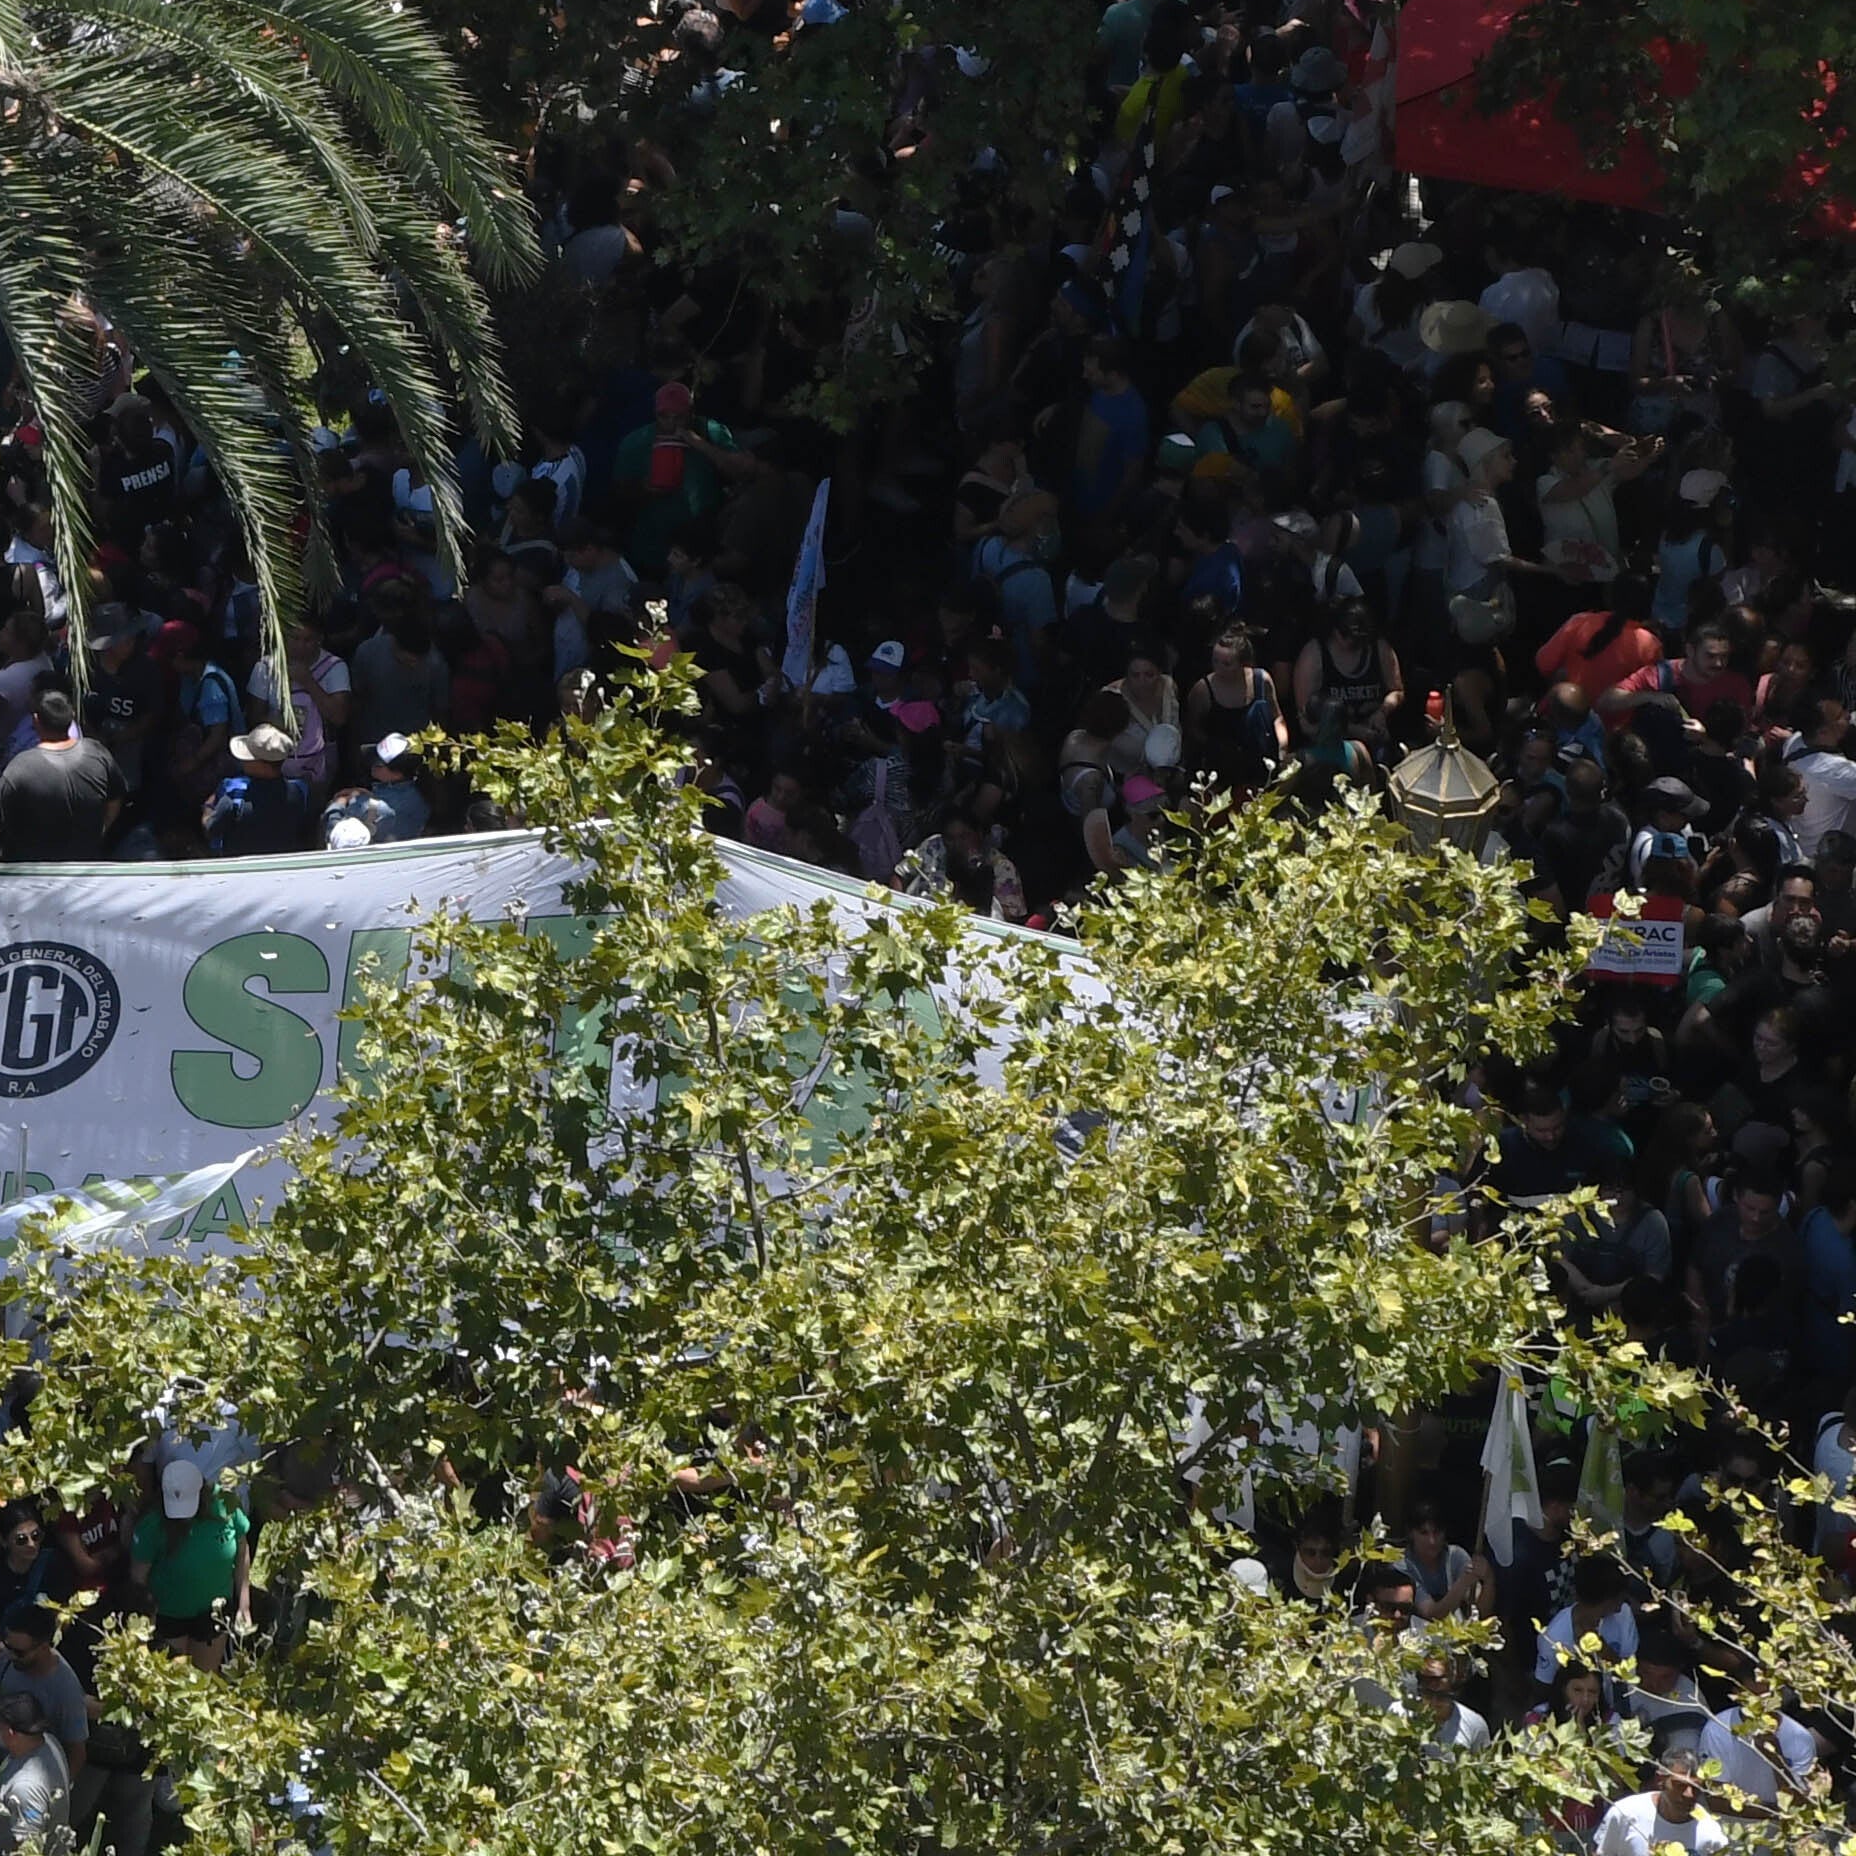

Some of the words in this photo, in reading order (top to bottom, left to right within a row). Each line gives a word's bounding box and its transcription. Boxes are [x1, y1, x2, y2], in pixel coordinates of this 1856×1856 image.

[120, 461, 171, 493] PRENSA
[8, 948, 82, 969] GENERAL
[82, 964, 105, 991] DEL
[81, 989, 112, 1058] TRABAJO
